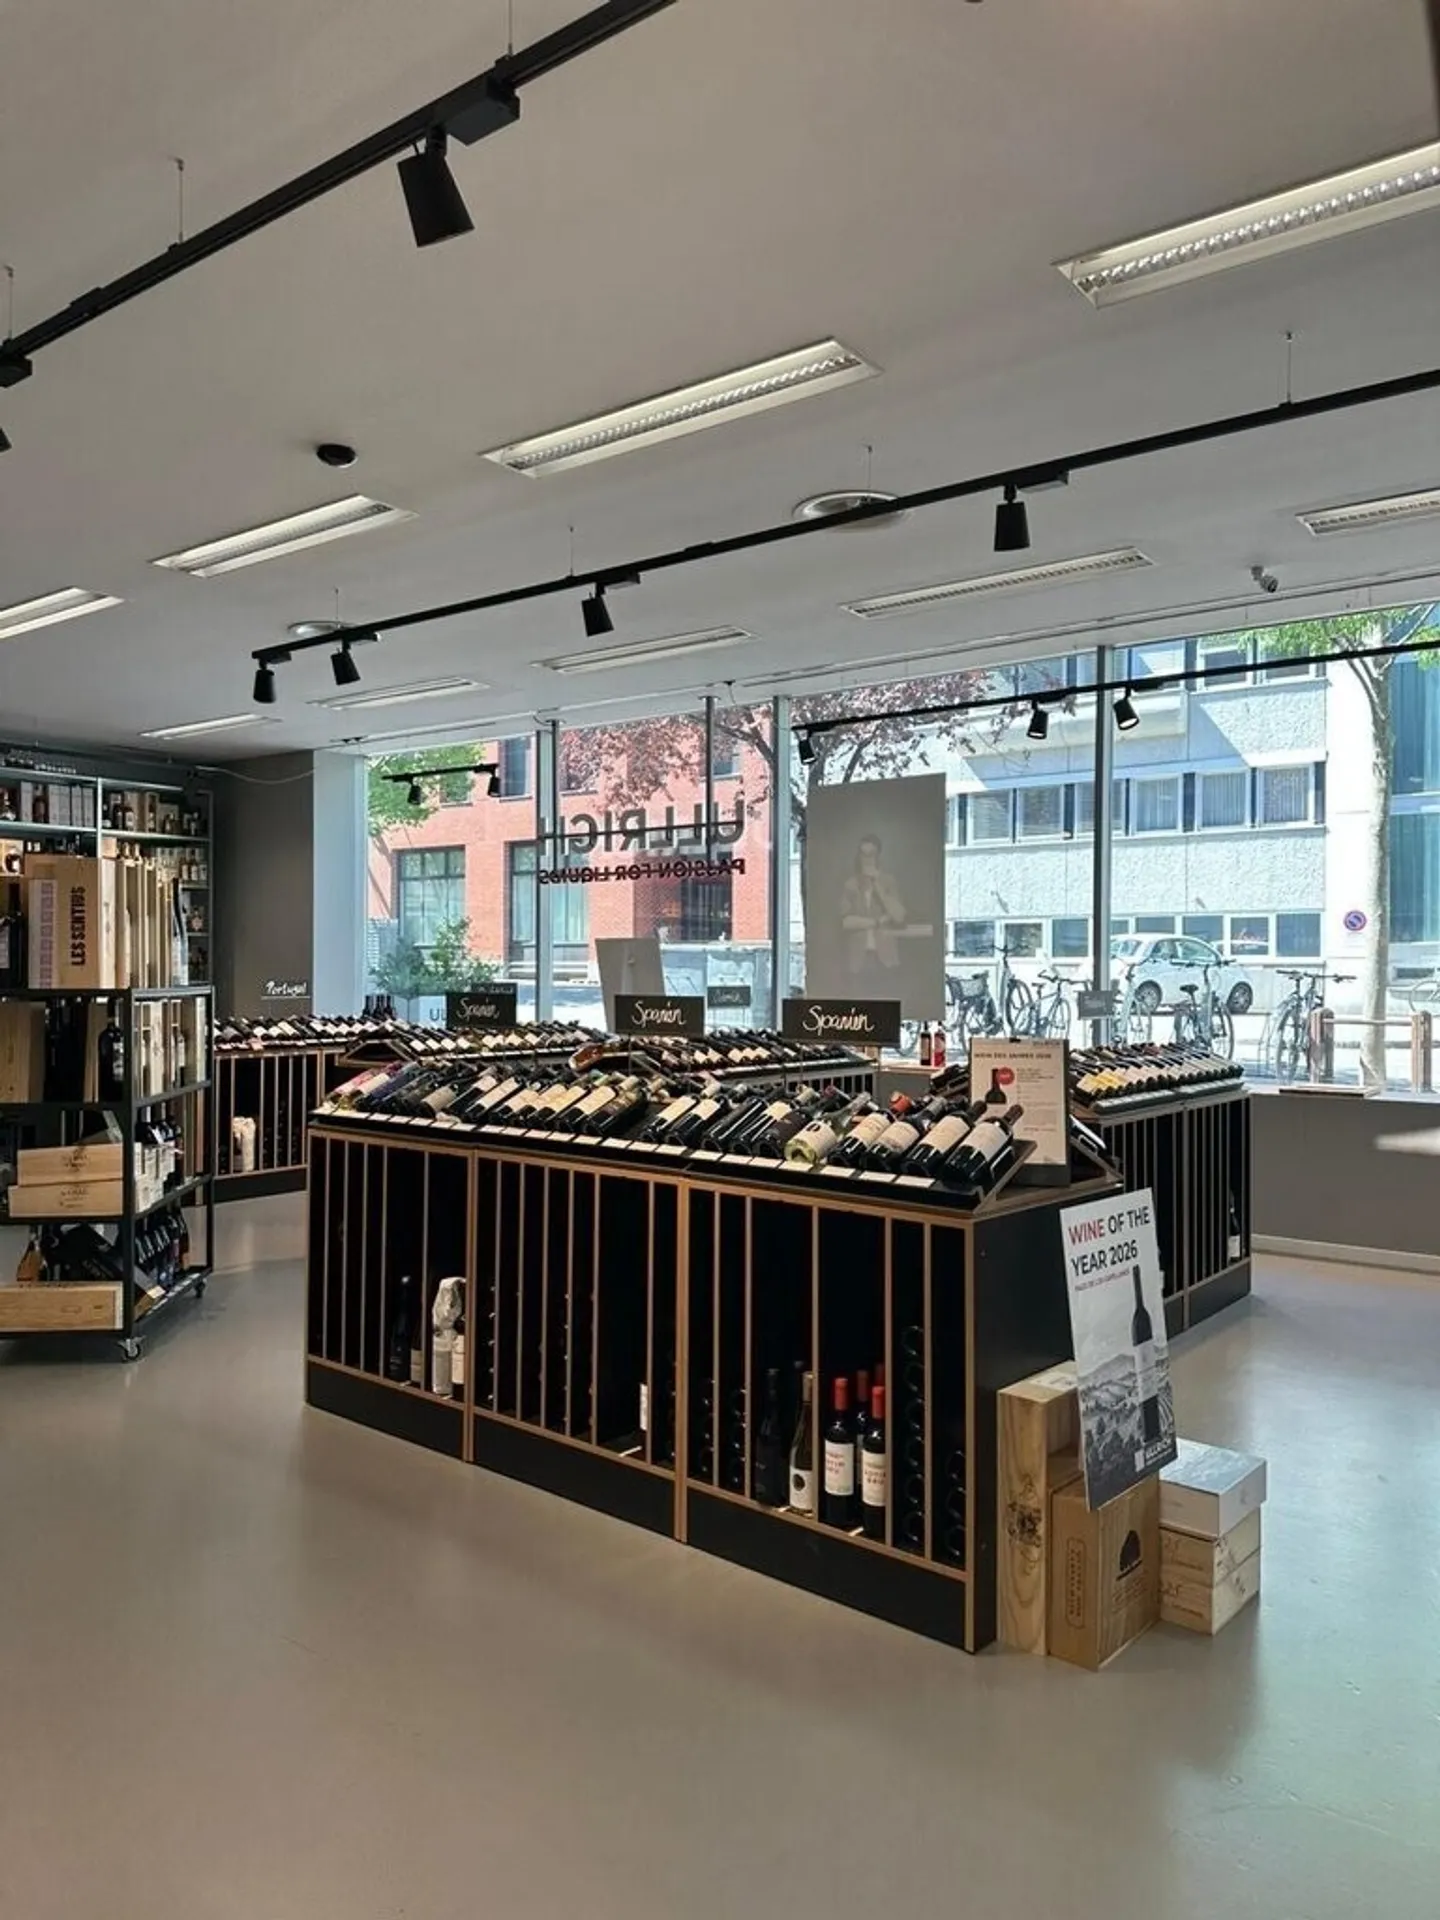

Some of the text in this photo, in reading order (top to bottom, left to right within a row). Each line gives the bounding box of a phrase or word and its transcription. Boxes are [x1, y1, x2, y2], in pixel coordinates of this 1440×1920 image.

[265, 980, 307, 997] Portugal
[802, 1005, 876, 1037] Spanien
[1068, 1205, 1150, 1246] WINE OF THE
[1071, 1239, 1138, 1277] YEAR 2026
